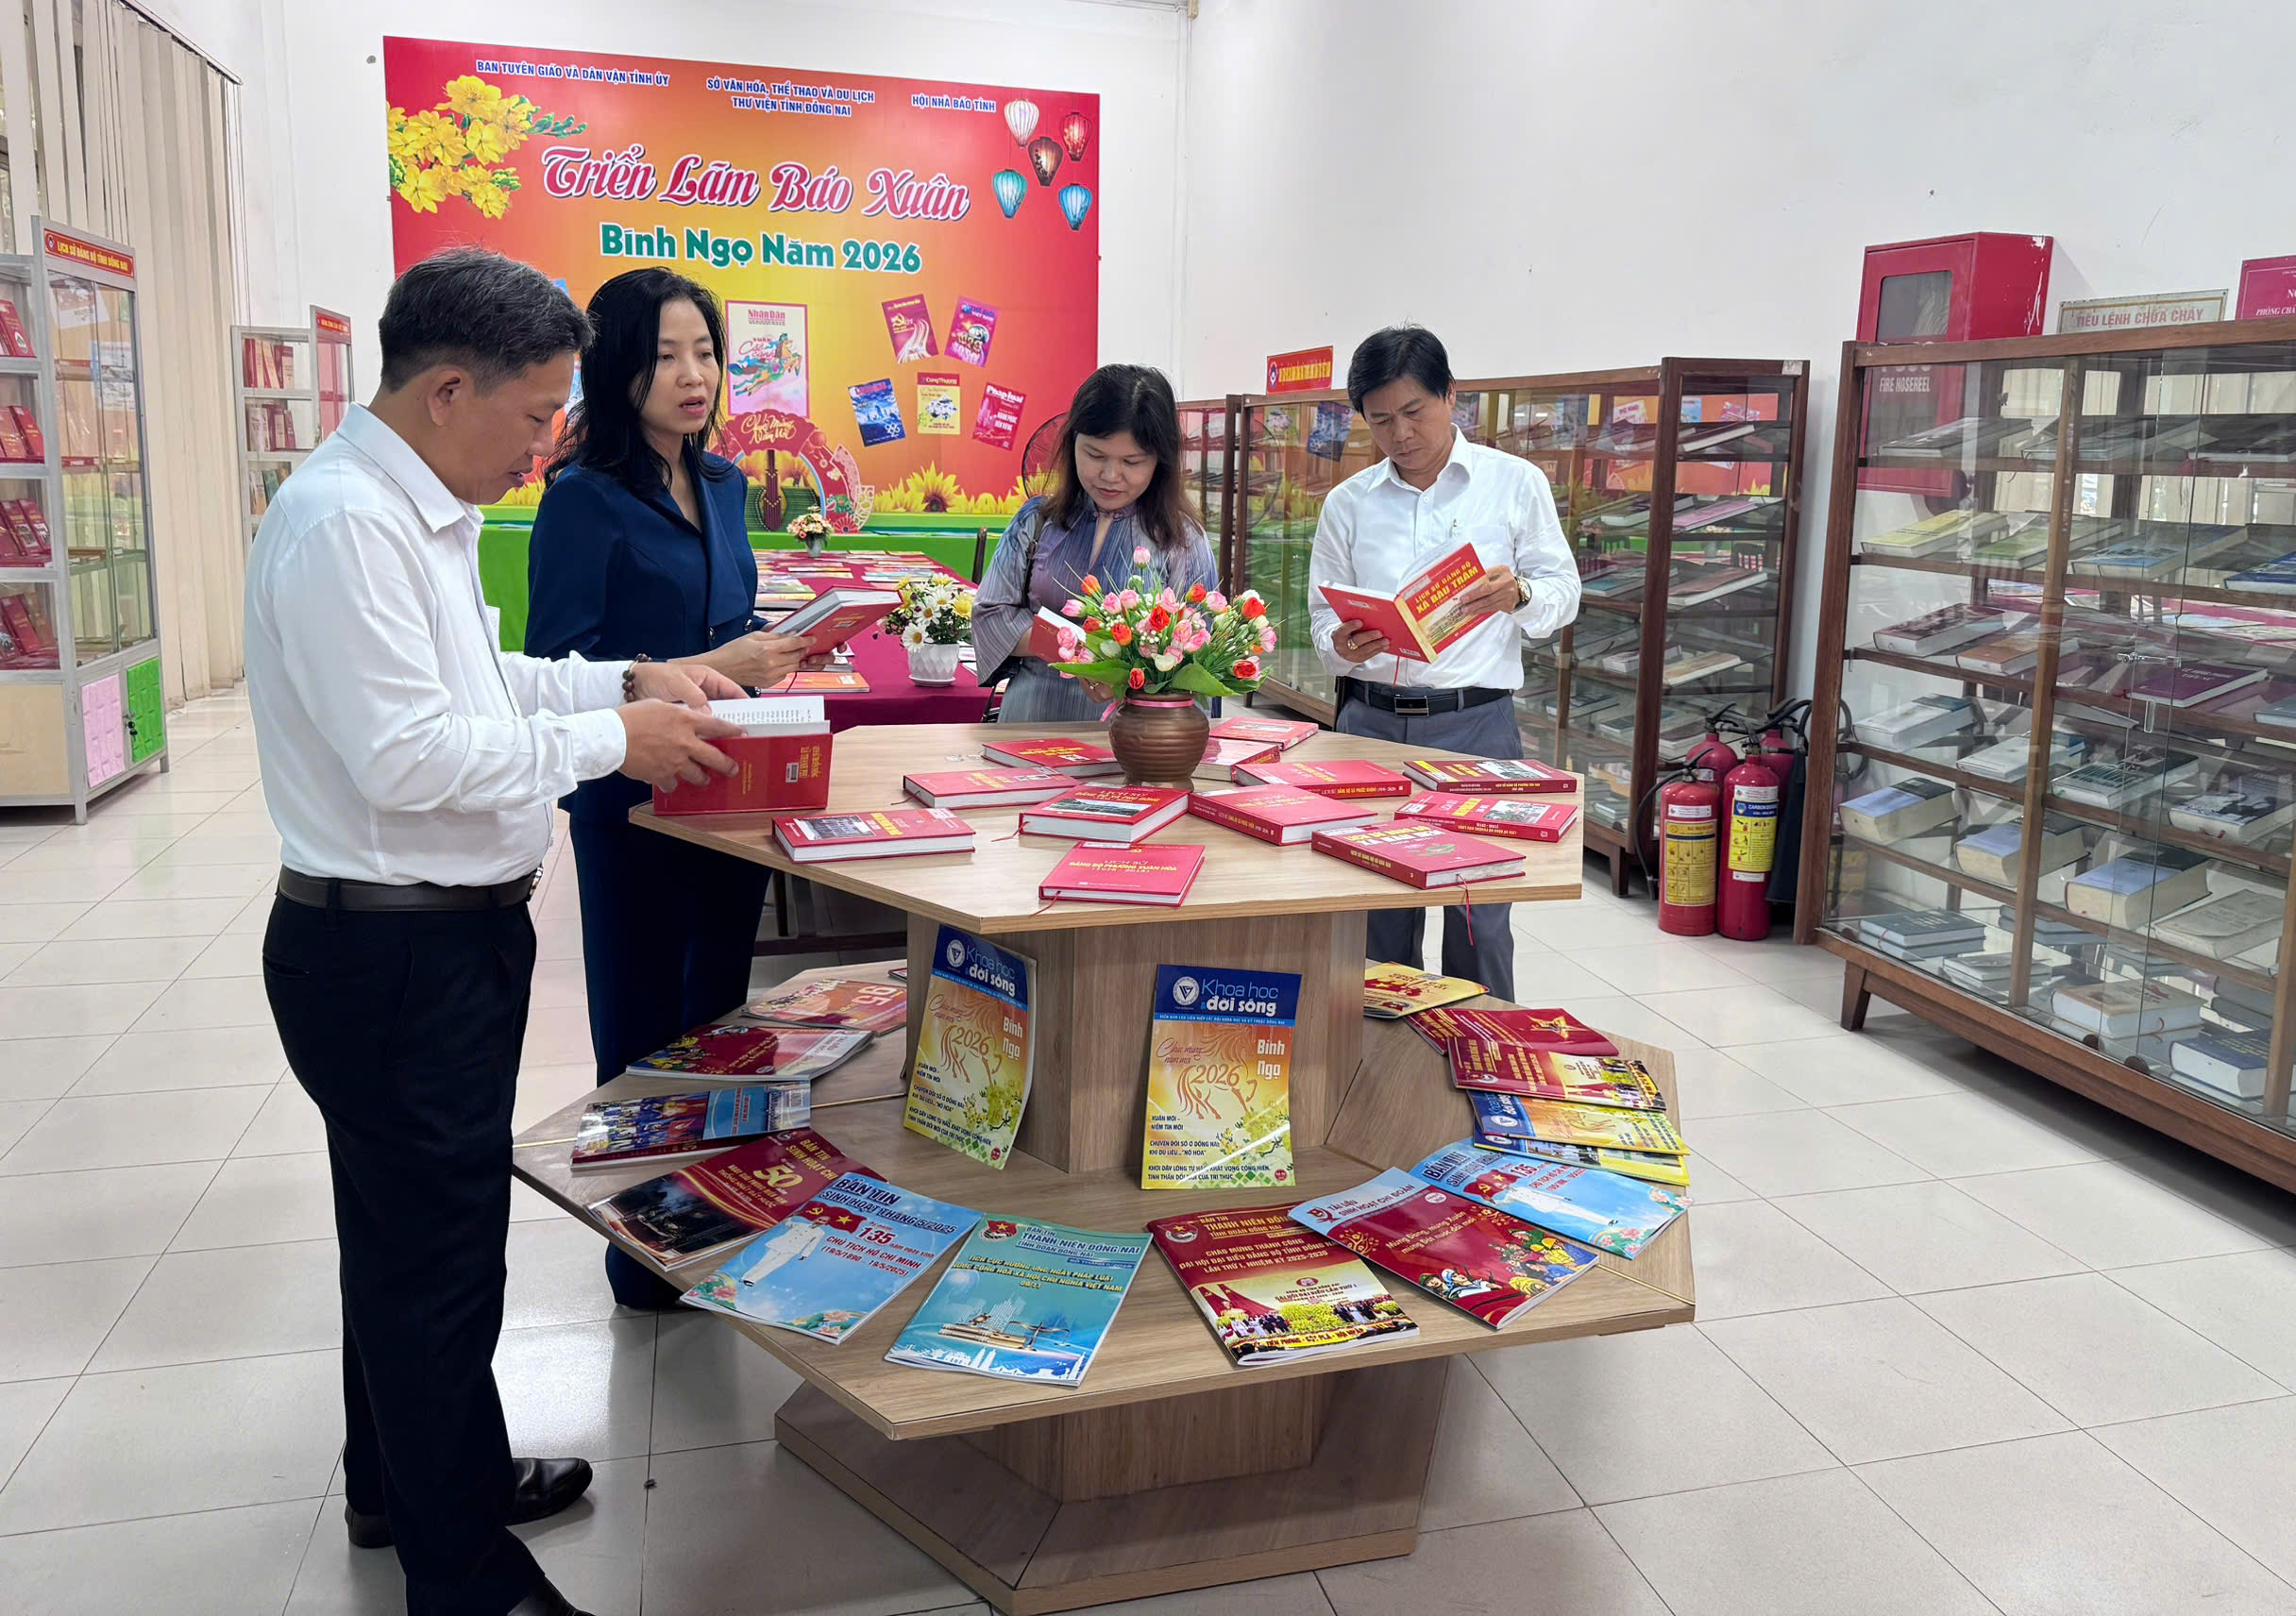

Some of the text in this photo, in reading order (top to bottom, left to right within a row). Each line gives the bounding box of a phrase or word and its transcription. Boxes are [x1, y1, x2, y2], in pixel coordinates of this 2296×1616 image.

[478, 61, 669, 86] BAN TUYÊN GIÁO VÀ DÂN VẬN TỈNH ỦY
[708, 77, 874, 103] SỞ VĂN HÓA, THỂ THAO VÀ DU LỊCH
[733, 98, 850, 115] THƯ VIỆN TỈNH ĐỒNG NAI
[913, 93, 995, 110] HỘI NHÀ BÁO TỈNH
[543, 144, 971, 220] Triển Lãm Báo Xuân
[600, 223, 921, 273] Bính Ngọ Năm 2026
[1880, 377, 1931, 392] FIRE HOSEREEL
[969, 964, 1015, 997] đời sống
[1202, 978, 1245, 997] Khoa
[1207, 996, 1235, 1012] đời
[1238, 998, 1276, 1017] sống
[1004, 1017, 1022, 1038] Bính
[952, 1027, 992, 1055] 2026
[1257, 1039, 1285, 1055] Bính
[1190, 1064, 1242, 1086] 2026
[1258, 1060, 1280, 1081] Ngọ
[801, 1139, 831, 1161] BẢN TIN
[785, 1145, 838, 1180] SINH HOẠT CHI
[1511, 1163, 1538, 1177] 135
[753, 1164, 803, 1188] 50
[835, 1178, 901, 1206] BẢN TIN
[1339, 1207, 1359, 1216] SINH
[1359, 1200, 1379, 1211] HOẠT
[1392, 1185, 1415, 1200] ĐOÀN
[820, 1191, 957, 1234] SINH HOẠT THÁNG 5/2025
[1328, 1200, 1358, 1211] TÀI LIỆU
[1204, 1220, 1240, 1231] THANH
[1241, 1217, 1265, 1228] NIÊN
[857, 1227, 896, 1245] 135
[1021, 1233, 1140, 1254] THANH NIÊN ĐỒNG NAI
[826, 1236, 921, 1270] CHỦ TỊCH HỒ CHÍ MINH
[1206, 1237, 1305, 1257] CHÀO MỪNG THÀNH CÔNG
